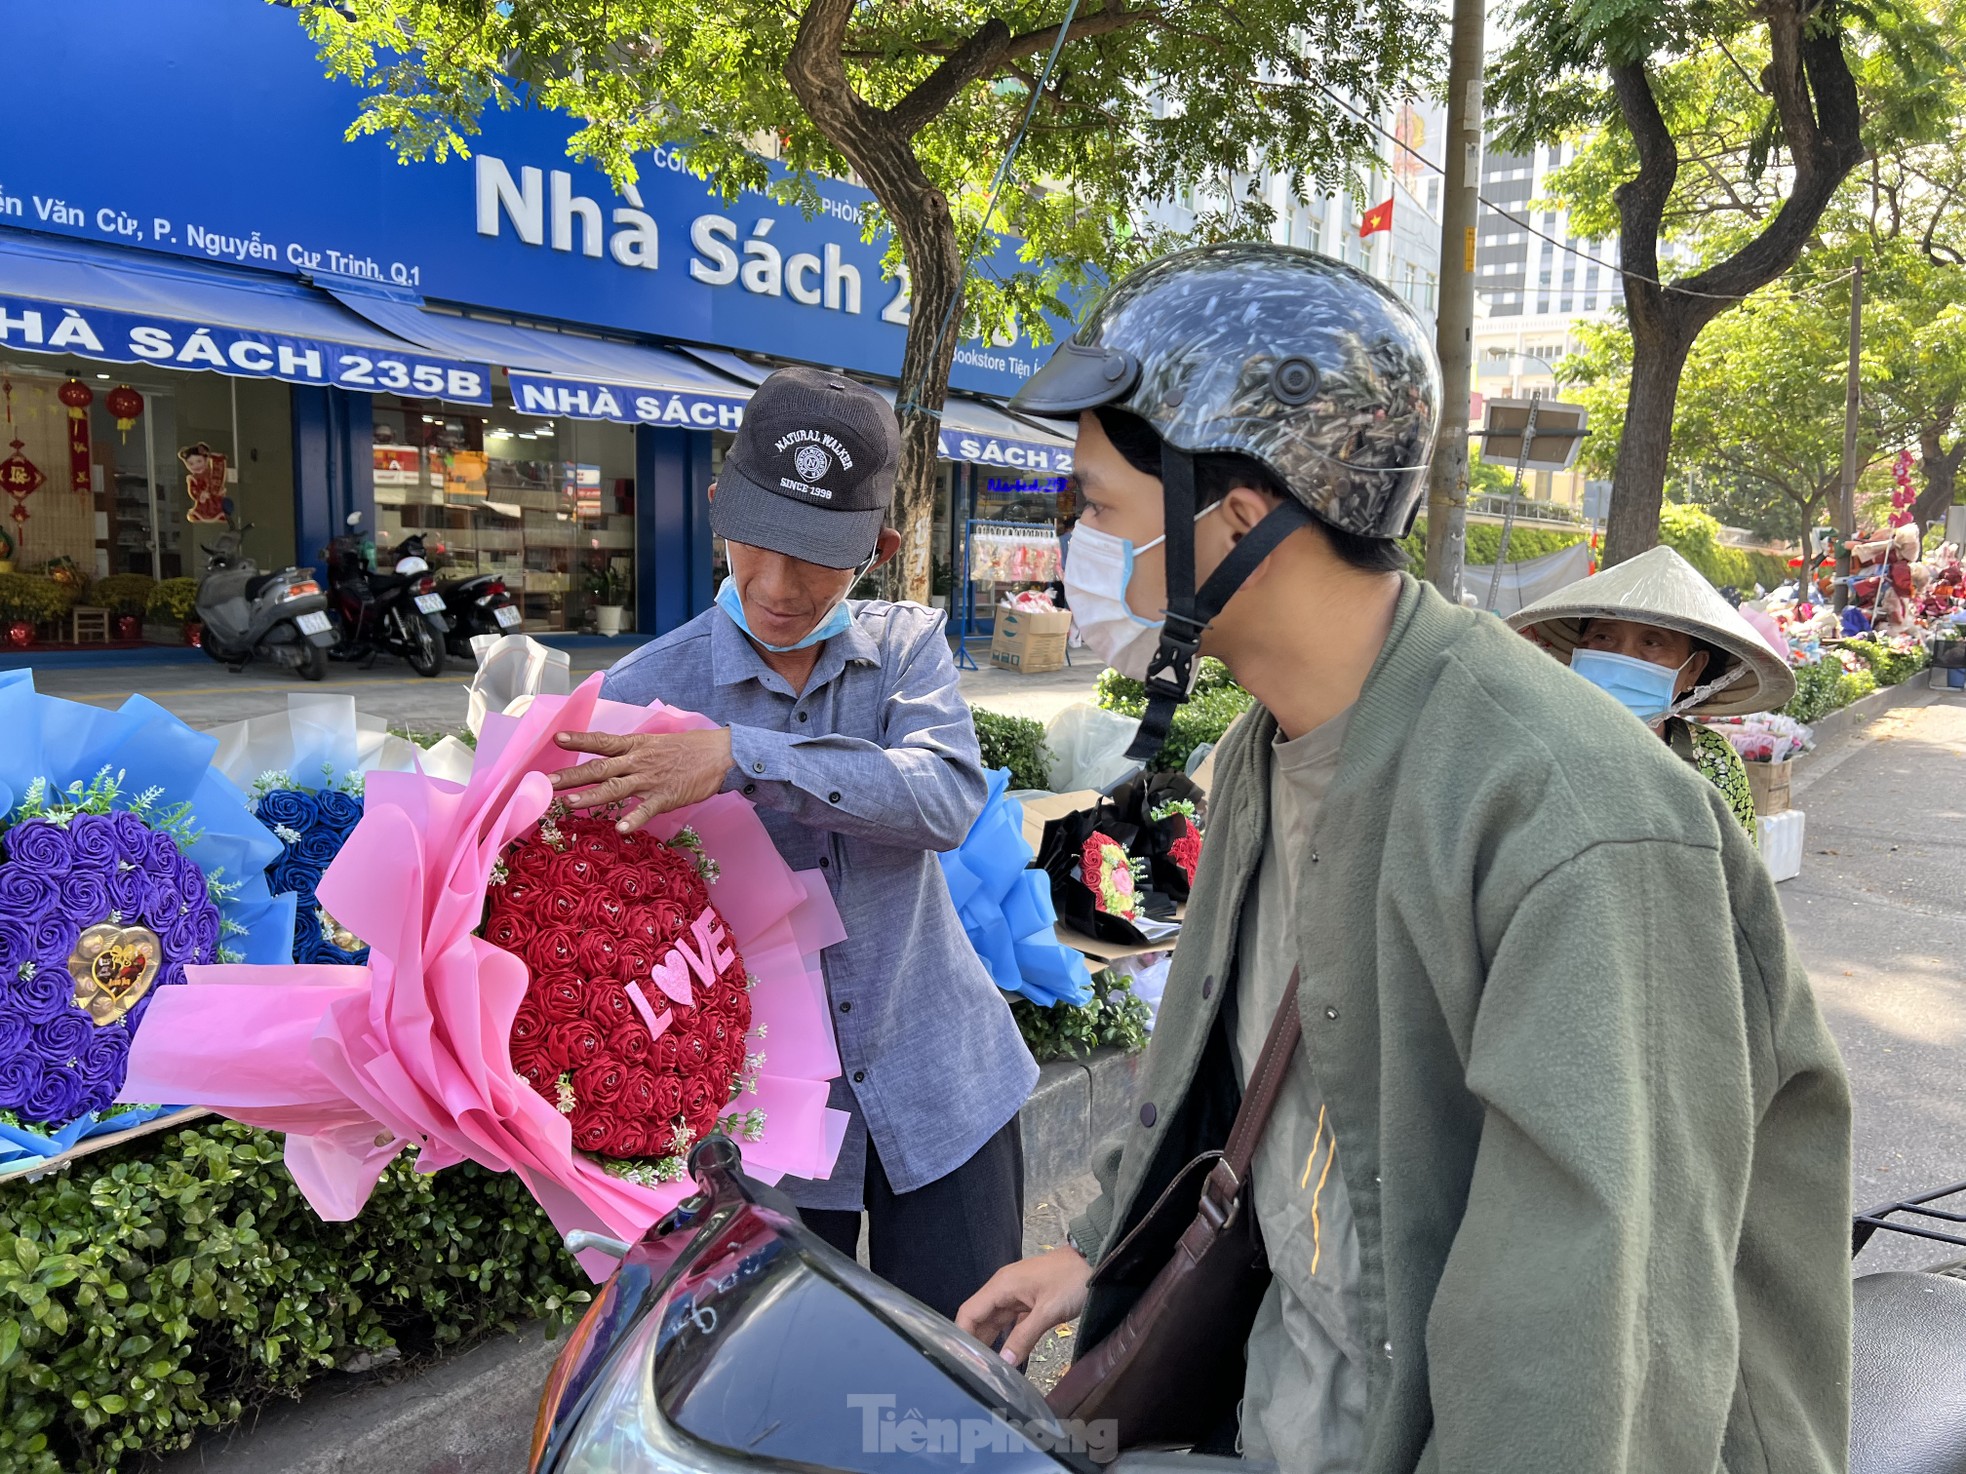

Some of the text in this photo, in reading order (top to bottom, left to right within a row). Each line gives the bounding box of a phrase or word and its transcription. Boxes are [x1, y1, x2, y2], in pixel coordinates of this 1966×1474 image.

[32, 195, 85, 227] Văn
[97, 208, 143, 241] Cừ,
[153, 218, 177, 243] P.
[187, 224, 277, 260] Nguyễn
[391, 262, 420, 286] Q.1
[476, 154, 658, 270] Nhà
[690, 214, 861, 314] Sách
[128, 326, 322, 378] SÁCH
[339, 355, 482, 397] 235B
[1008, 357, 1030, 379] Tiện
[522, 384, 745, 427] NHÀ SÁCH
[775, 429, 820, 453] NATURAL
[822, 433, 853, 471] WALKER
[960, 439, 1048, 468] SÁCH
[780, 477, 832, 499] SINCE 1998
